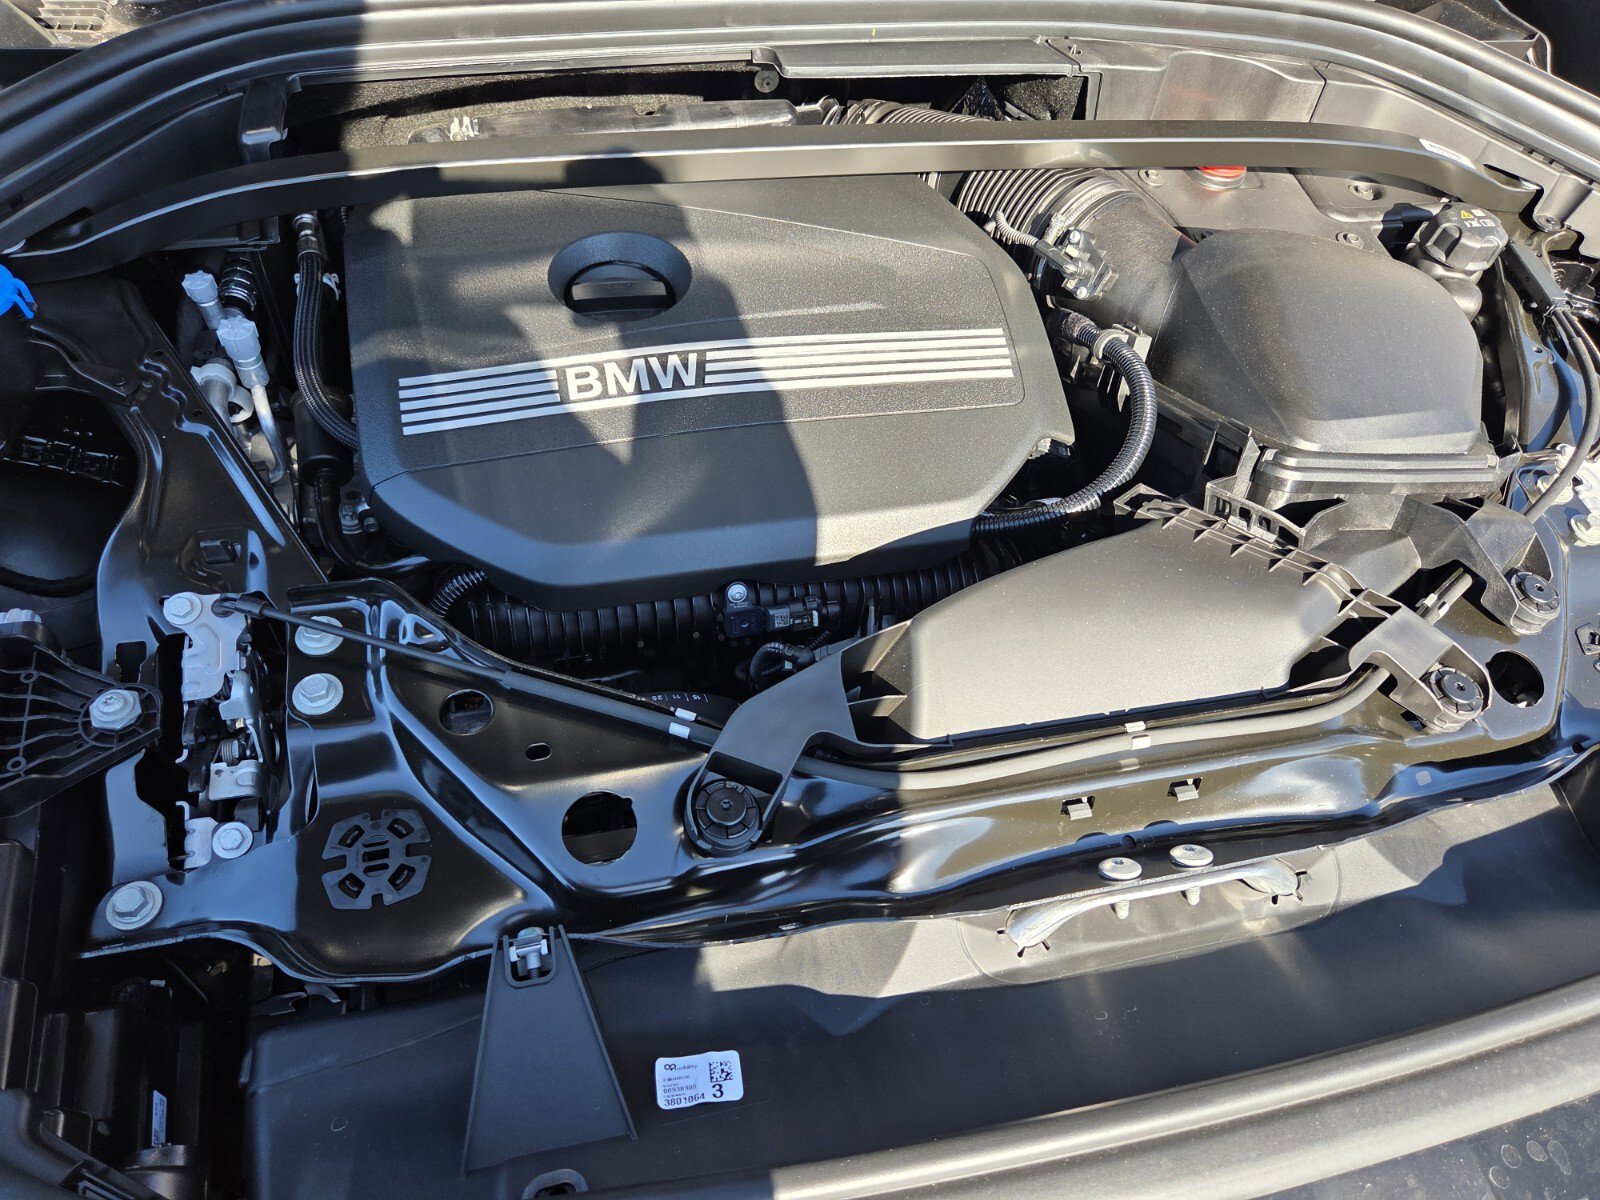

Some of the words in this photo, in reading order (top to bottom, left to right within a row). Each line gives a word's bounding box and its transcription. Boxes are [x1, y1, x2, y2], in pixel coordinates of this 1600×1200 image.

[565, 352, 698, 401] BMW
[711, 1083, 724, 1099] 3
[663, 1092, 705, 1107] 3801064
